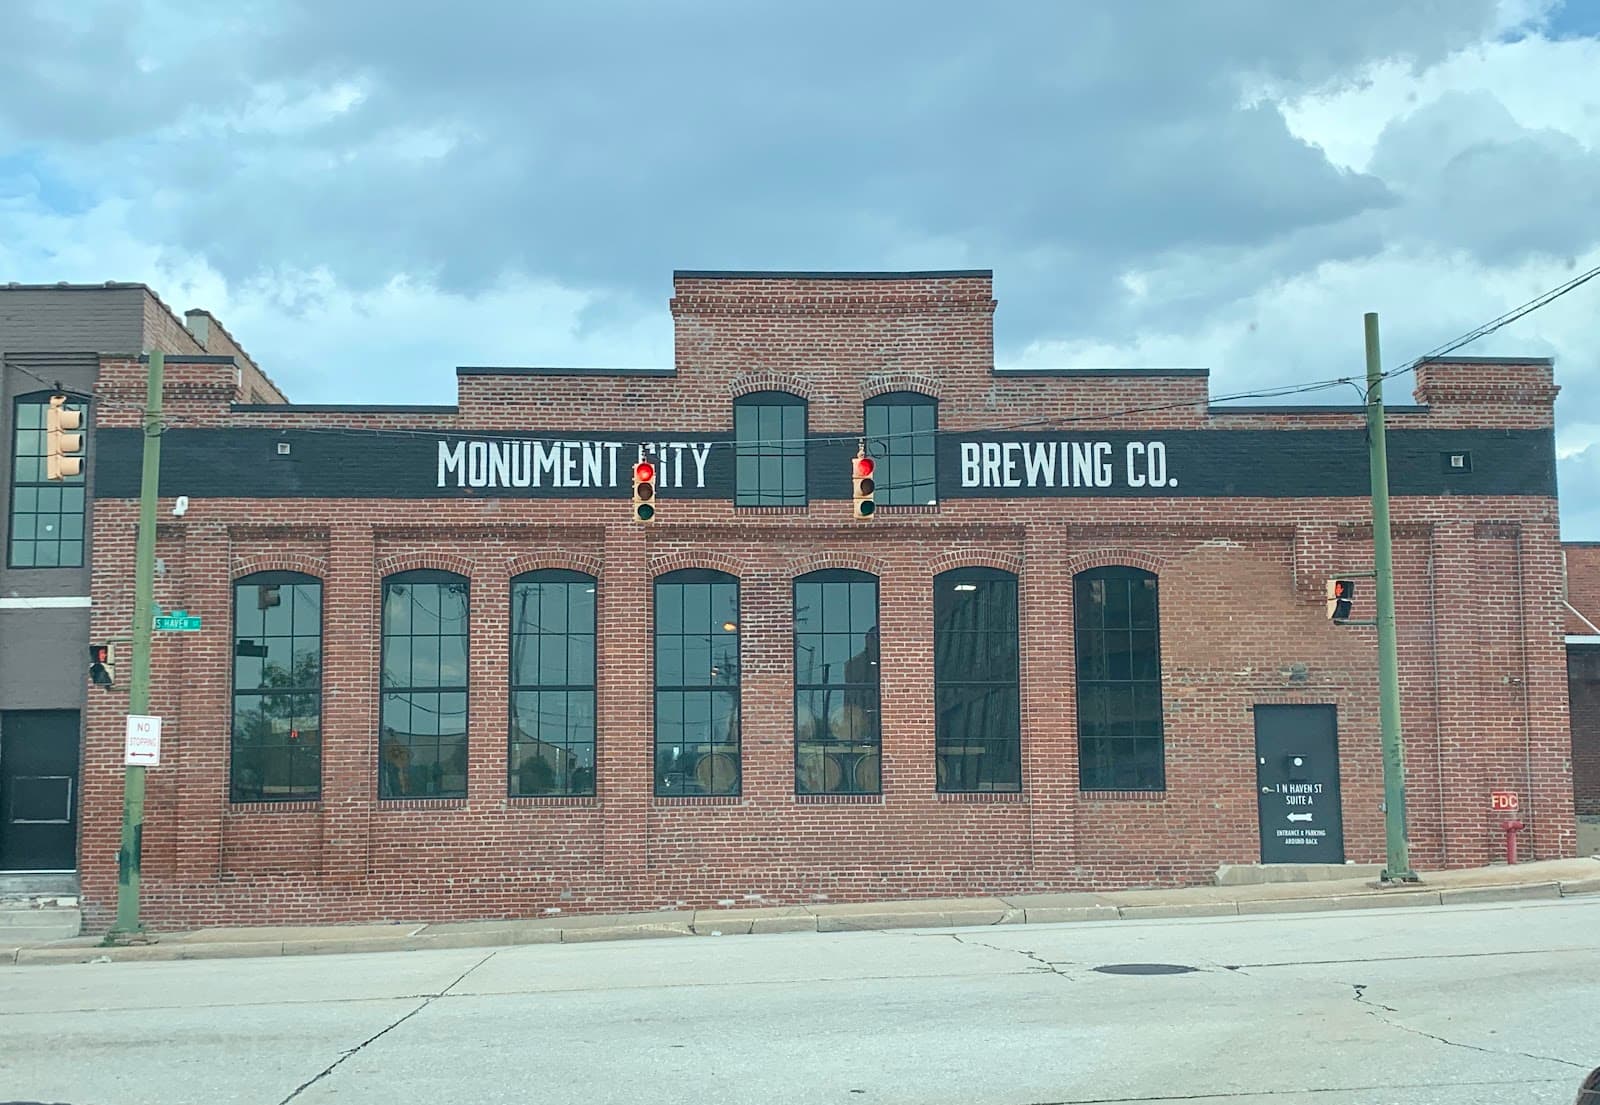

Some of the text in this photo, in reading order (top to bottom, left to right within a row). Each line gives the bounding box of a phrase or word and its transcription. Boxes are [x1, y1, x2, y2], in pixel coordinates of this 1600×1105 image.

[437, 440, 622, 488] MONUMENT
[960, 442, 1113, 488] BREWING
[1126, 441, 1179, 488] CO.
[156, 619, 161, 629] S
[163, 618, 189, 629] HAVEN
[137, 722, 151, 733] NO
[129, 736, 157, 747] STOPPING
[1276, 783, 1322, 794] 1 N HAVEN ST
[1286, 795, 1313, 805] SUITE A
[1492, 795, 1517, 808] FDC
[1276, 829, 1300, 837] ENTRANCE
[1304, 829, 1326, 837] PARKING
[1285, 837, 1305, 845] AROUND
